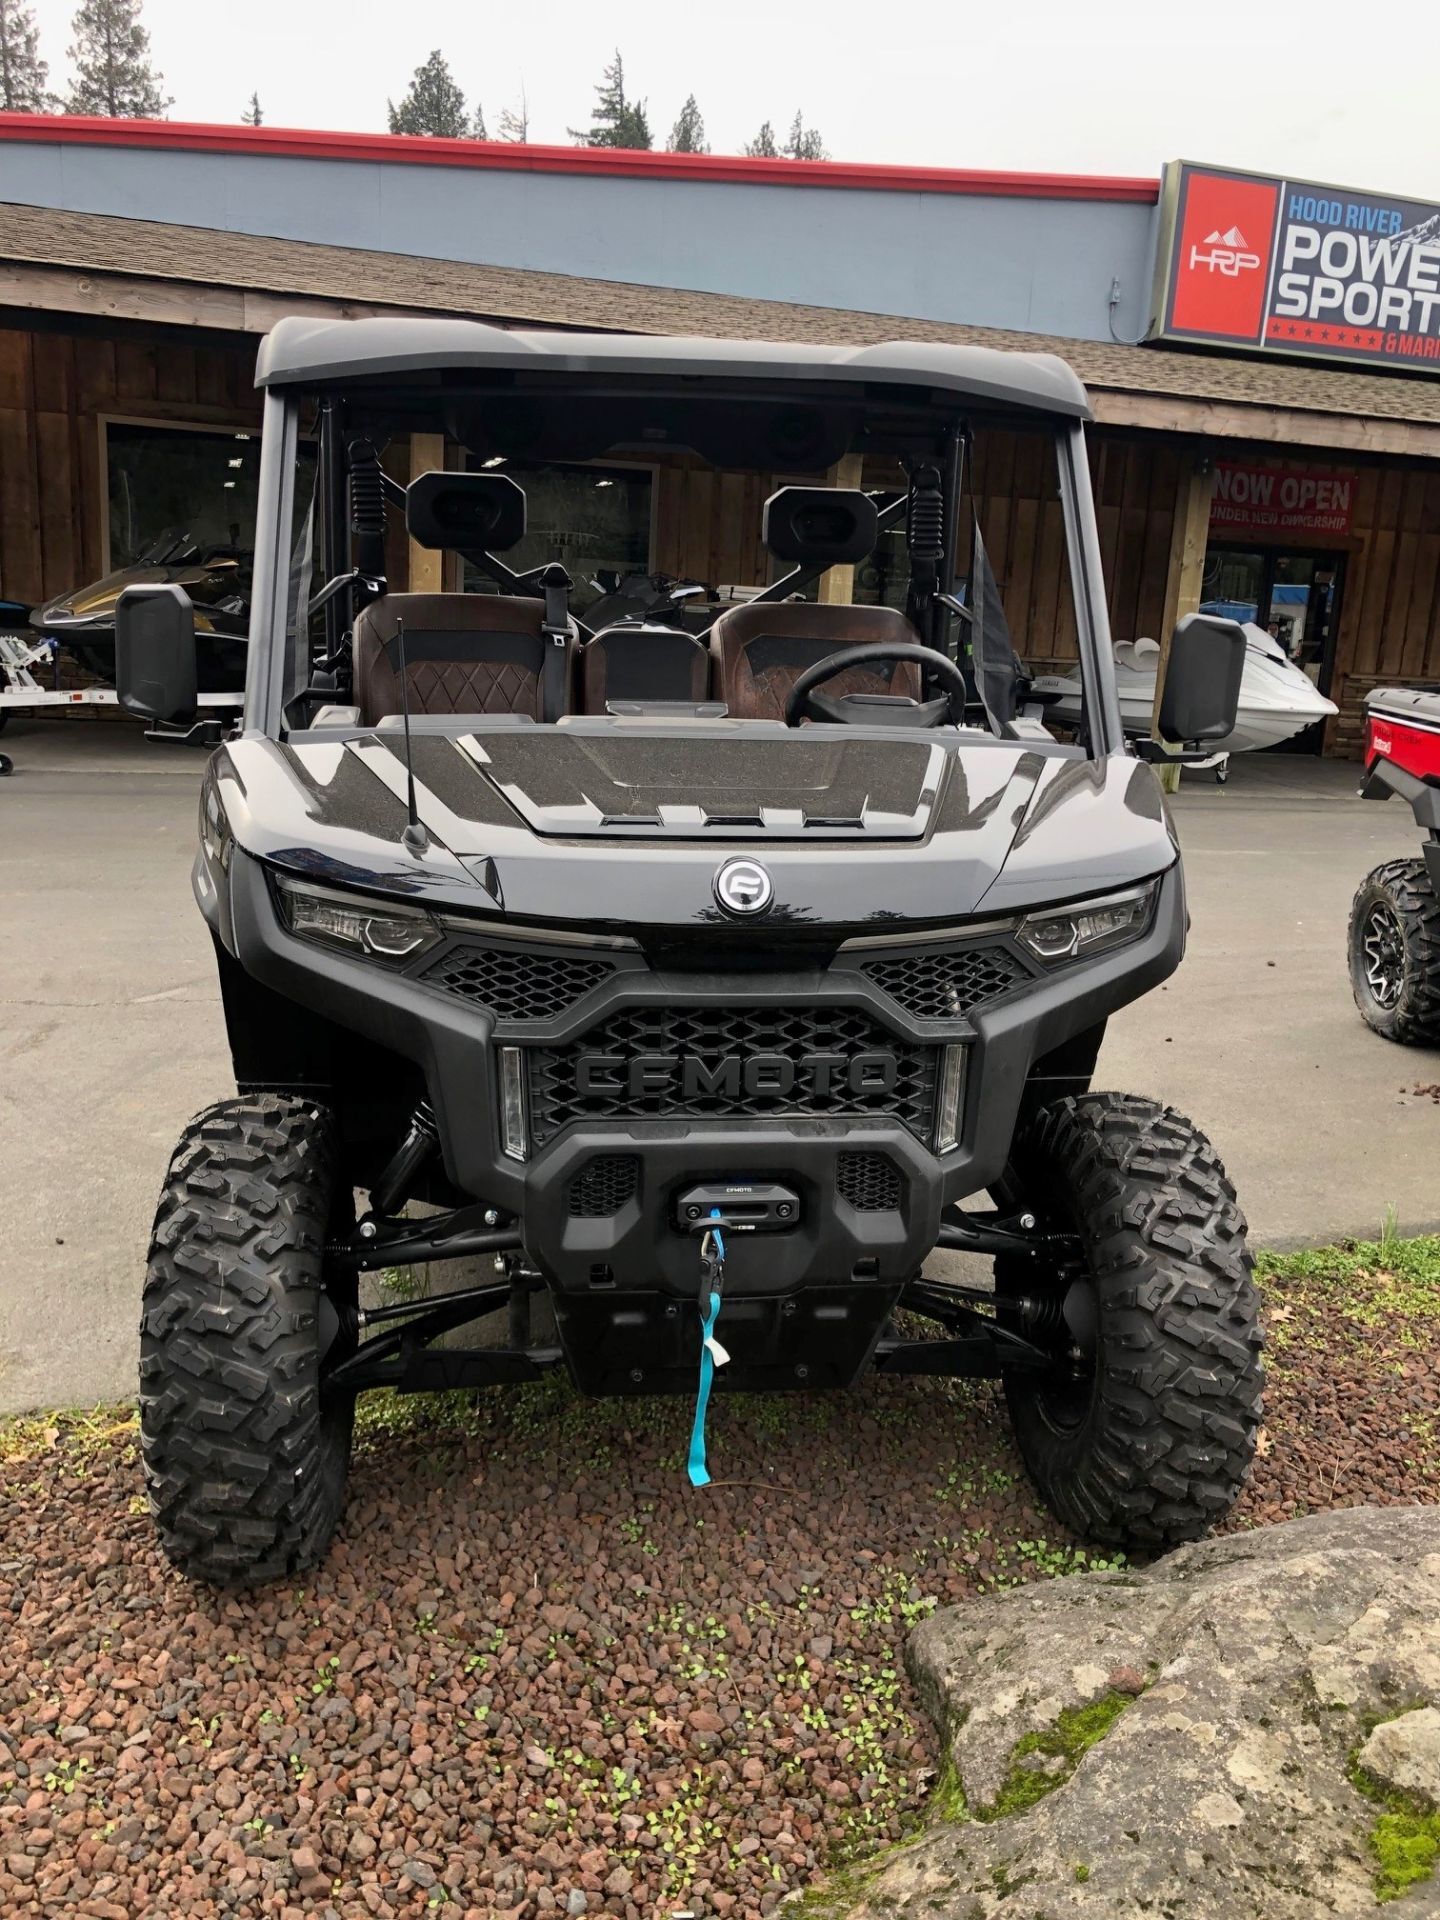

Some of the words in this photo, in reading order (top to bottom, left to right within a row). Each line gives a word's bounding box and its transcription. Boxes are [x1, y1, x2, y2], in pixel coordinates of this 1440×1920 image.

[1288, 195, 1342, 226] HOOD
[1345, 204, 1402, 235] RIVER
[1189, 245, 1261, 277] HRP
[1282, 224, 1439, 291] POWE
[1275, 273, 1440, 335] SPORT
[1385, 332, 1397, 354] &
[1398, 334, 1440, 360] MARI
[1211, 468, 1275, 506] NOW
[1280, 478, 1350, 511] OPEN
[1252, 511, 1278, 525] NEW
[1280, 514, 1347, 530] OWNERSHIP
[574, 1053, 899, 1098] CFMOTO
